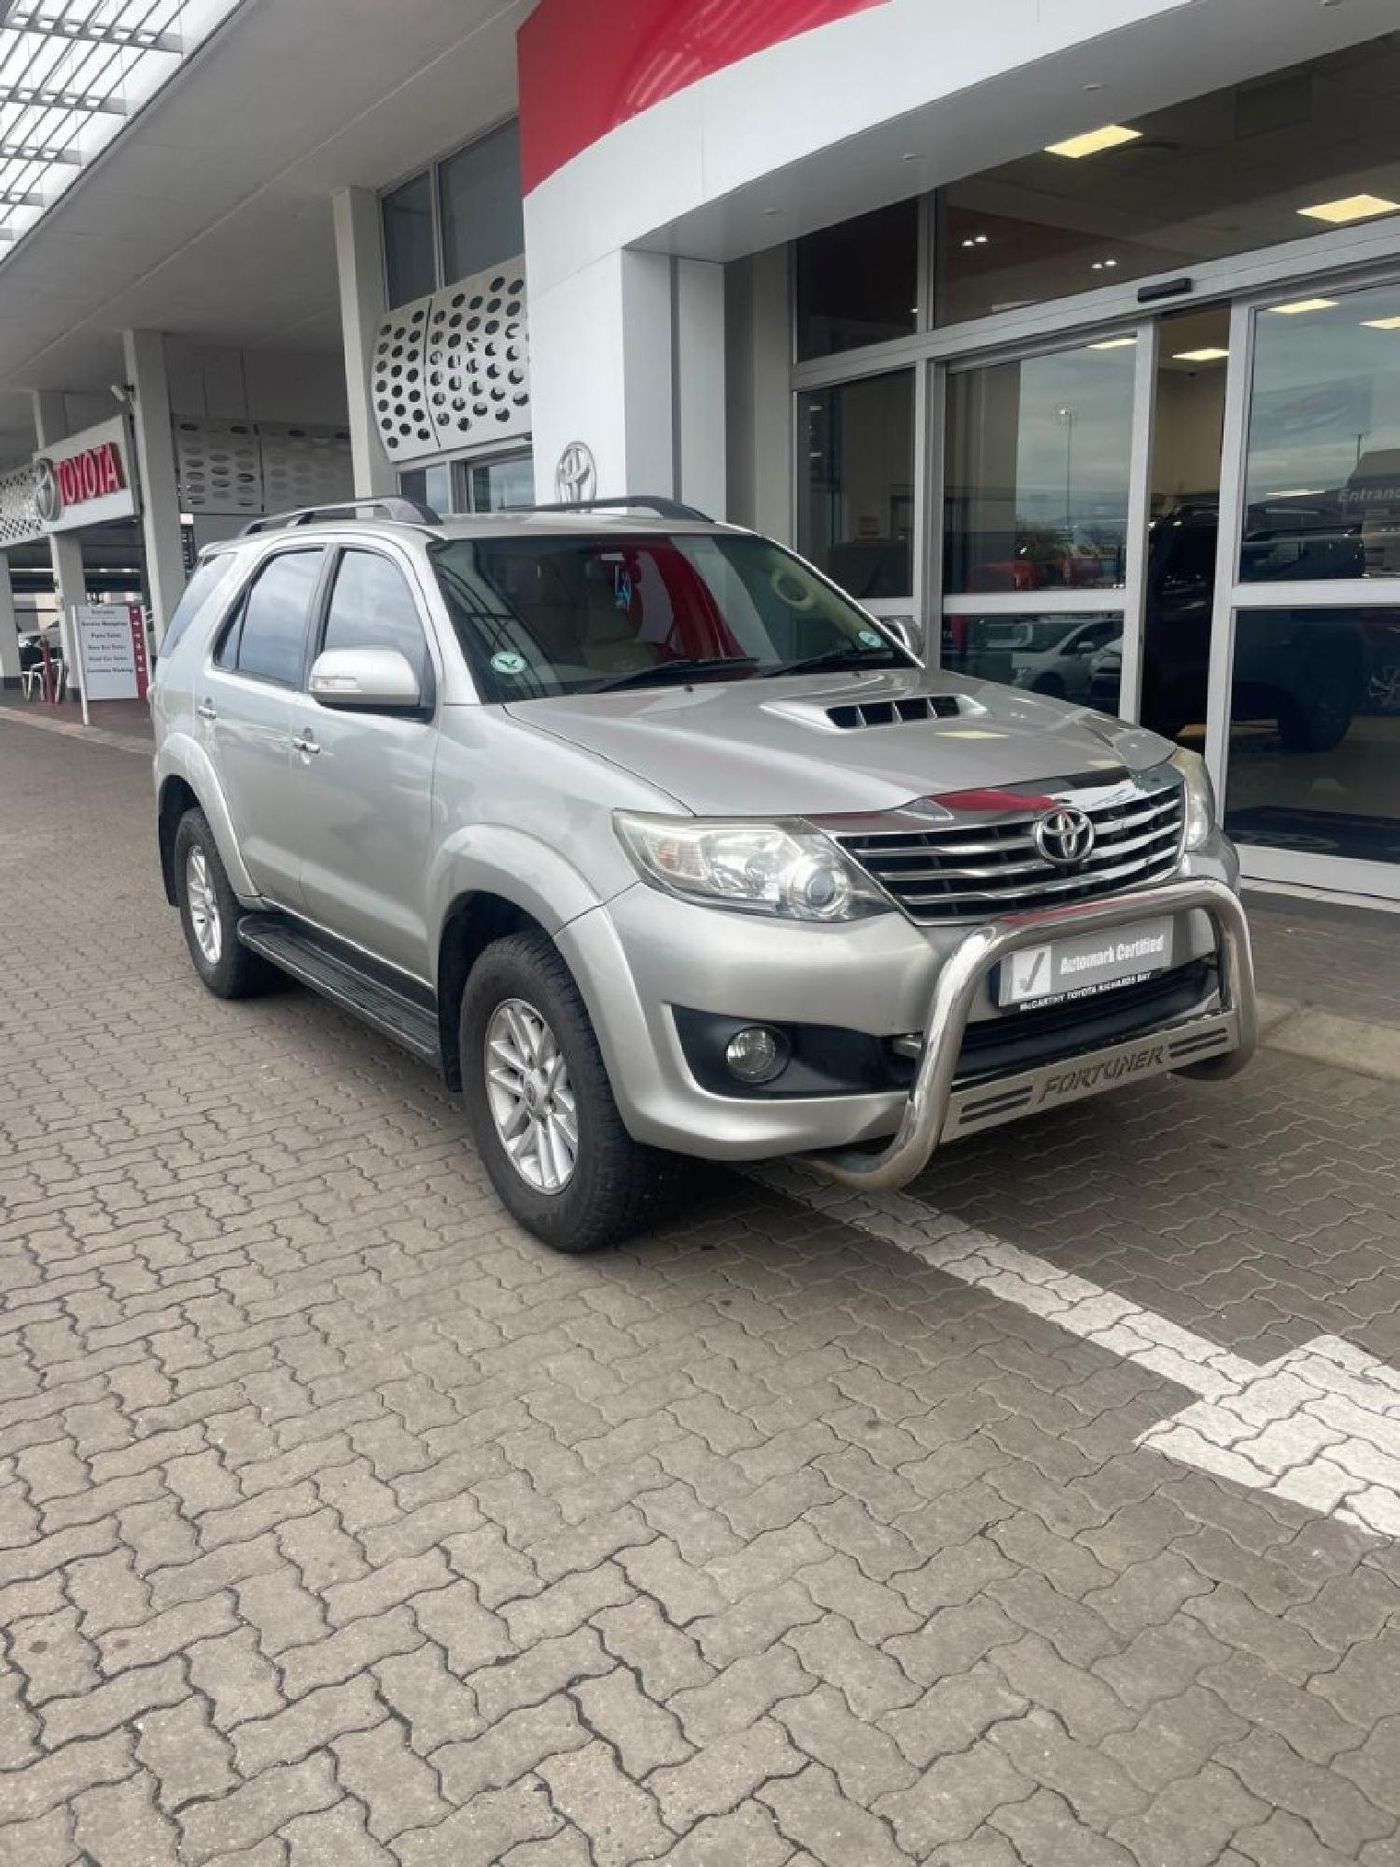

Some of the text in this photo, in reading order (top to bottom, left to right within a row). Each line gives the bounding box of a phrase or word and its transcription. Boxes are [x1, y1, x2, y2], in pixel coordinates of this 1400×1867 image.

[53, 442, 120, 507] TOYOTA
[1060, 935, 1164, 975] Automark Certified
[1067, 985, 1097, 999] TOYOTA
[1037, 1046, 1164, 1104] FORTUNER
